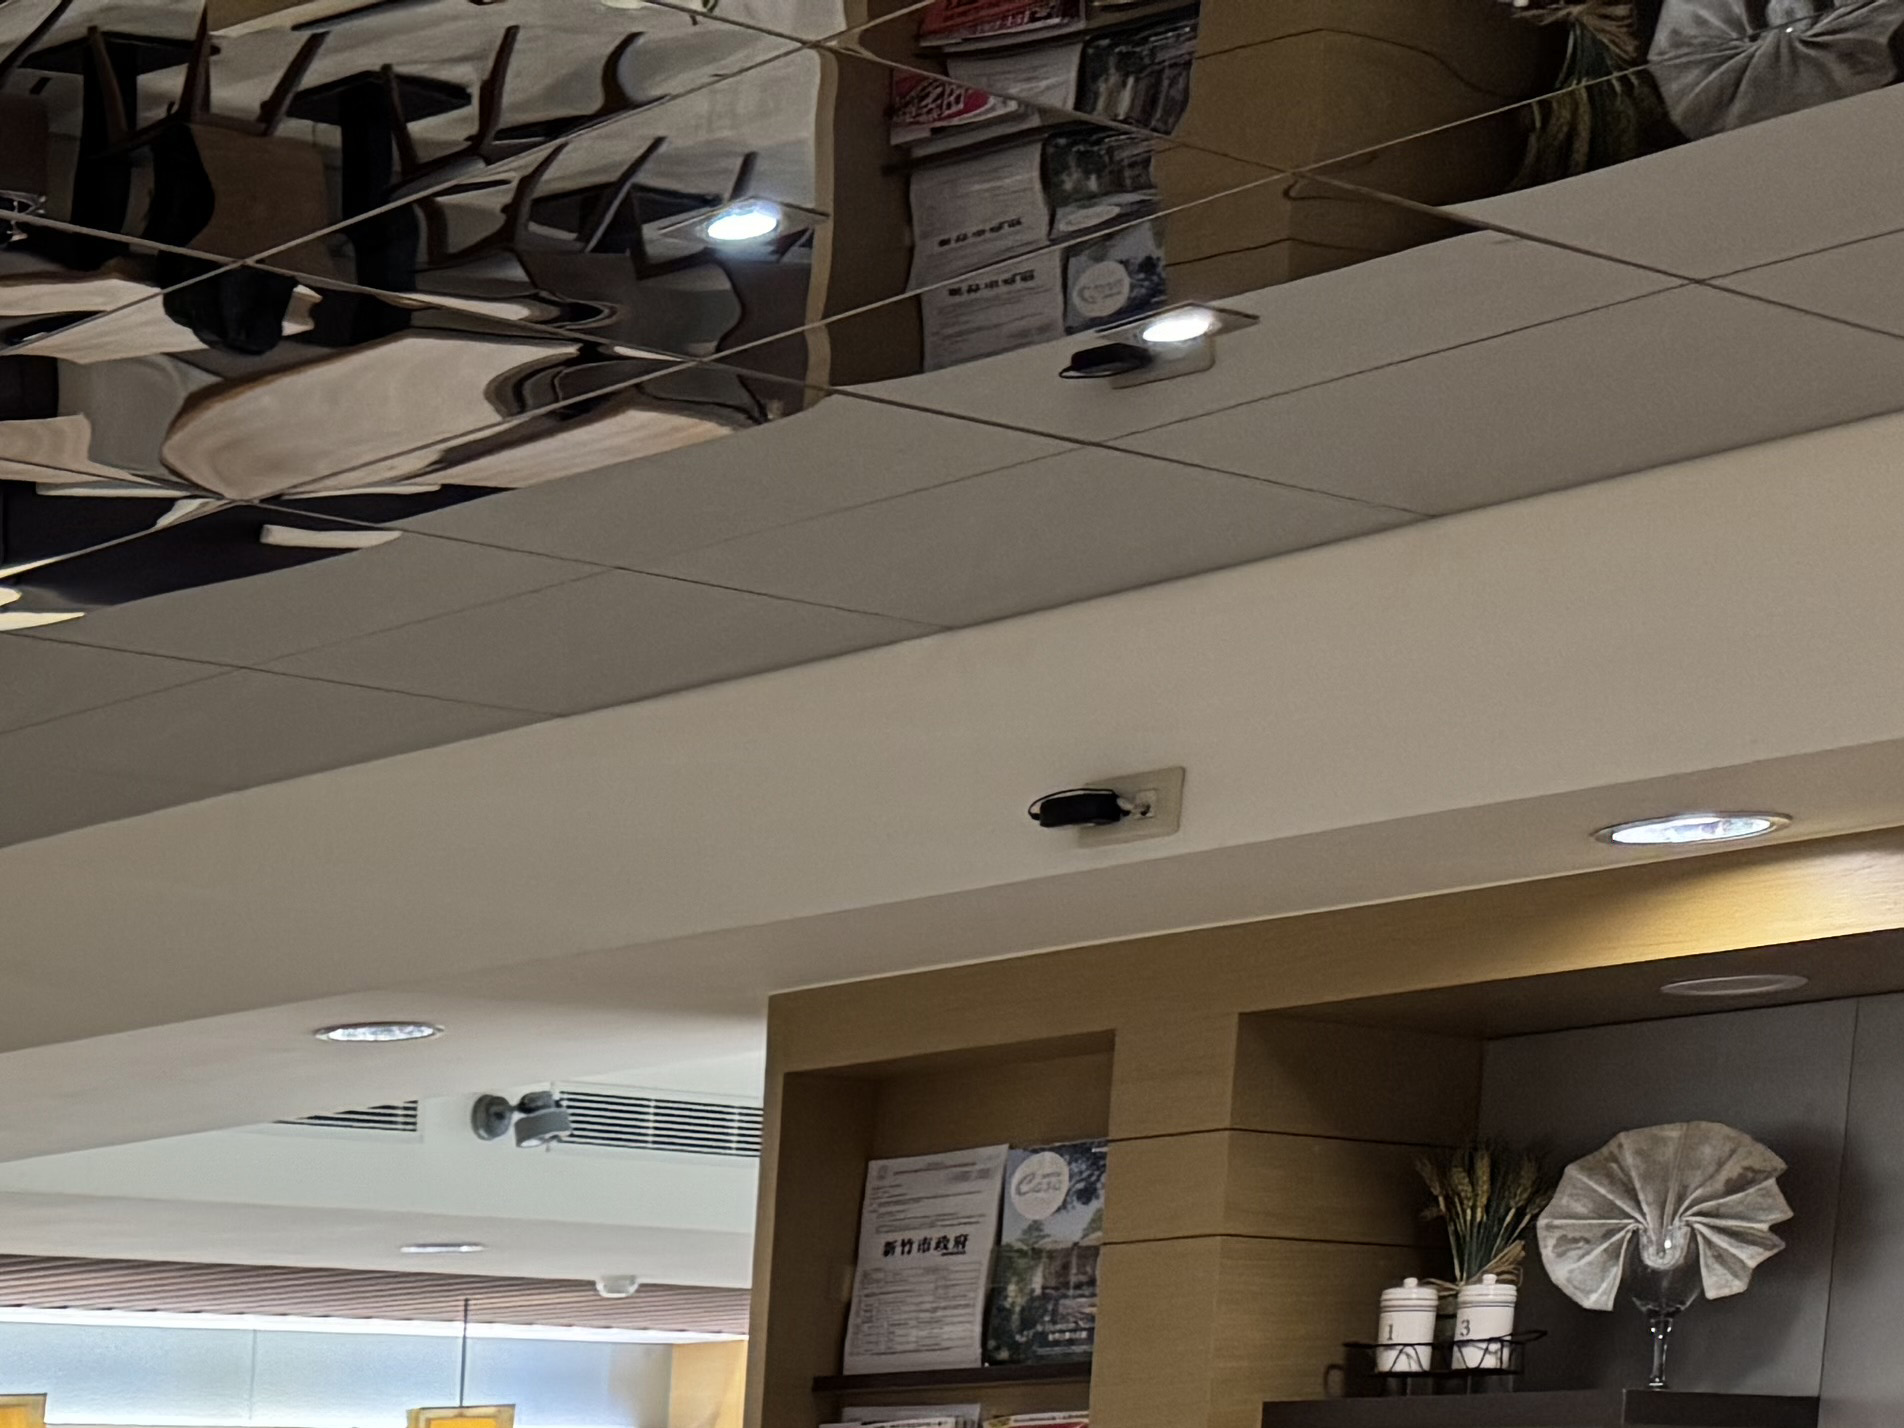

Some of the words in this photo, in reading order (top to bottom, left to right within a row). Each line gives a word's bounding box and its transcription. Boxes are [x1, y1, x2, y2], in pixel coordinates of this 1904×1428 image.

[882, 1233, 969, 1257] 新竹市政府
[1387, 1324, 1394, 1341] 1
[1460, 1319, 1471, 1337] 3
